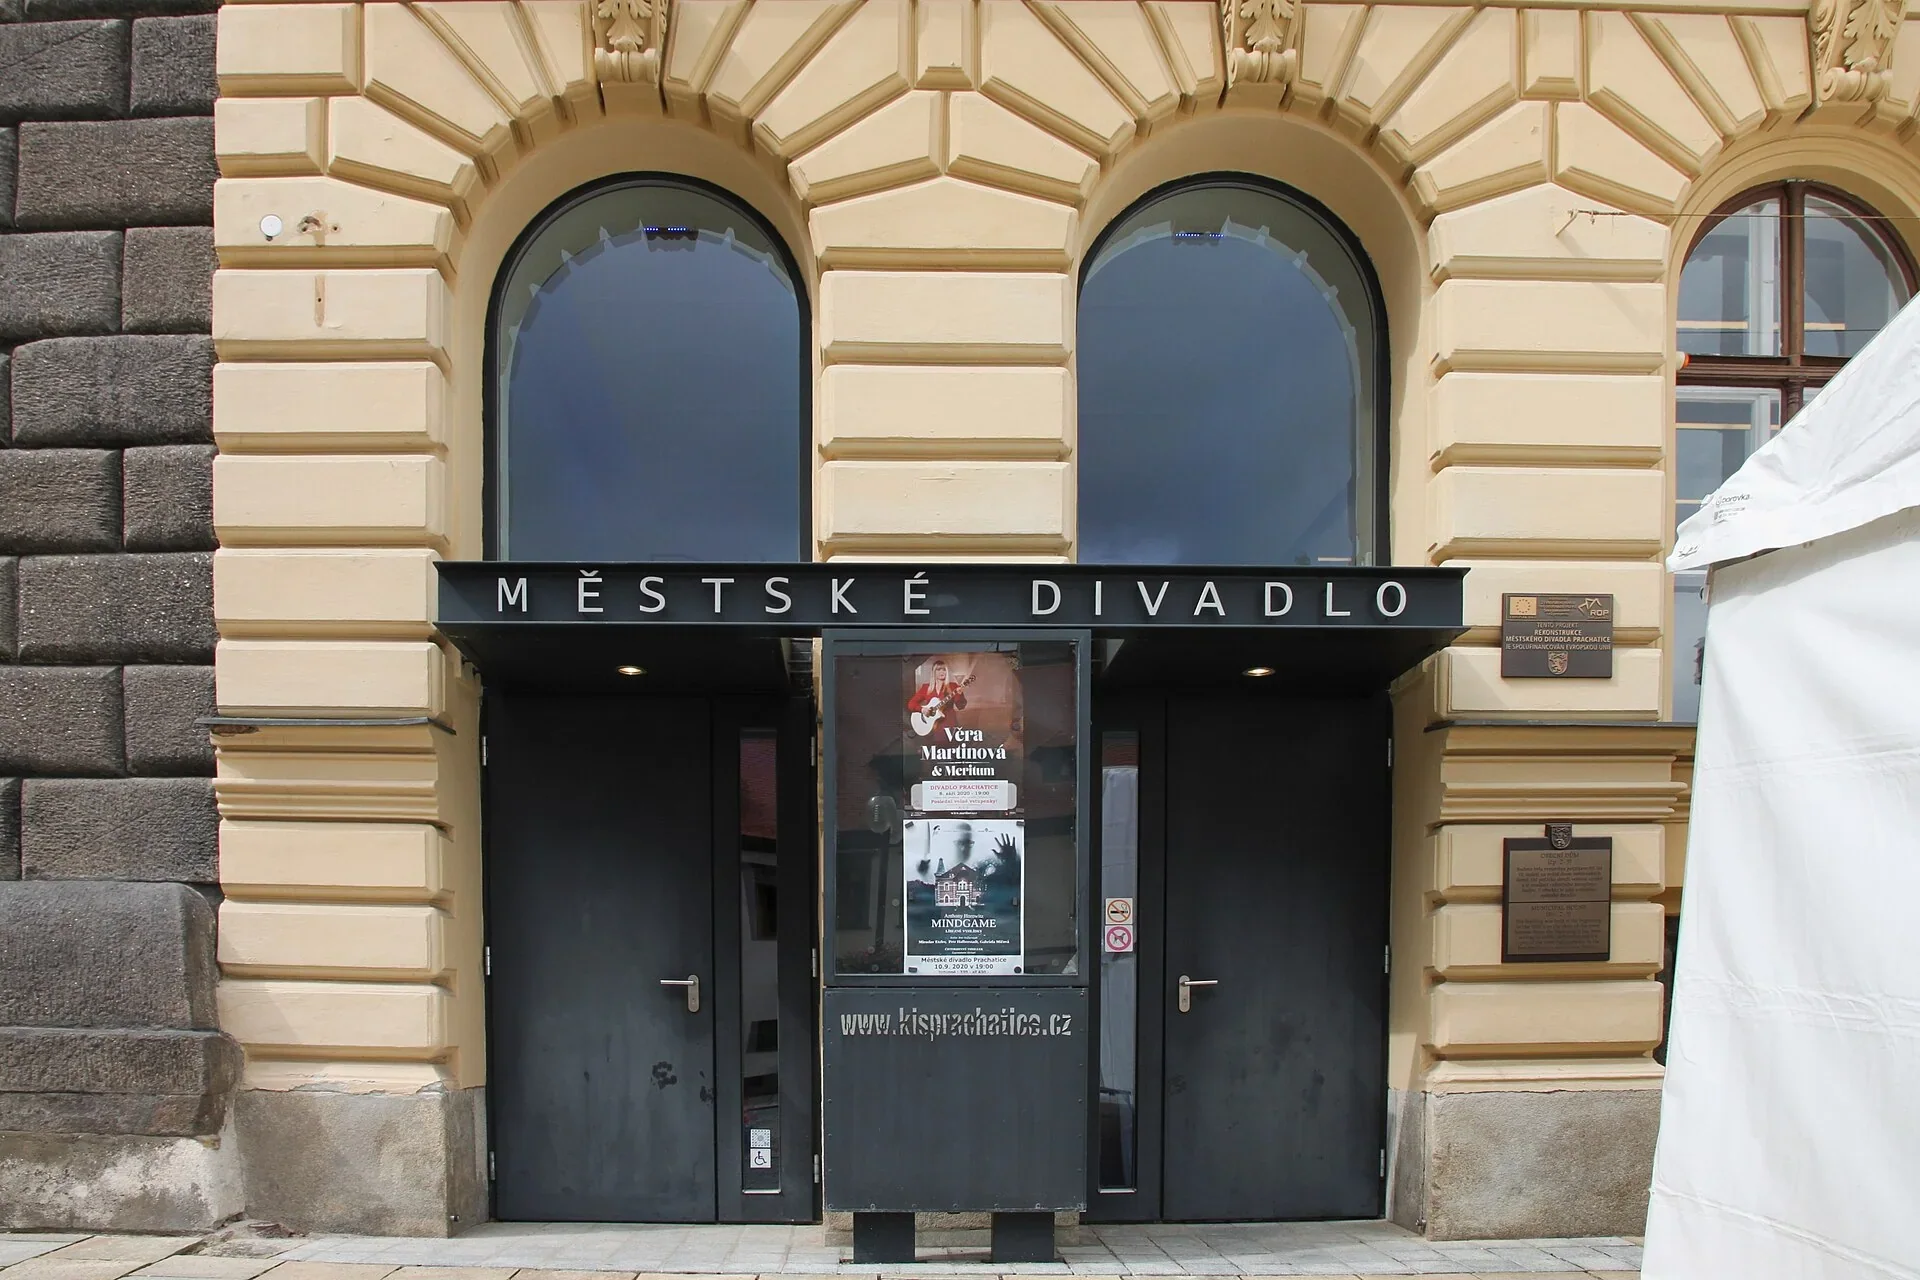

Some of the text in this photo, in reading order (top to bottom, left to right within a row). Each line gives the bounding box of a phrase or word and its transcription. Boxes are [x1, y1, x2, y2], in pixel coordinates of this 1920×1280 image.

[496, 569, 1407, 618] MĚSTSKÉ DIVADLO
[944, 726, 983, 742] Věra
[920, 743, 1007, 760] Martinová
[931, 764, 995, 776] & Meritum
[931, 919, 997, 928] MINDGAME
[840, 1007, 1072, 1041] www.kisprachatice.cz
